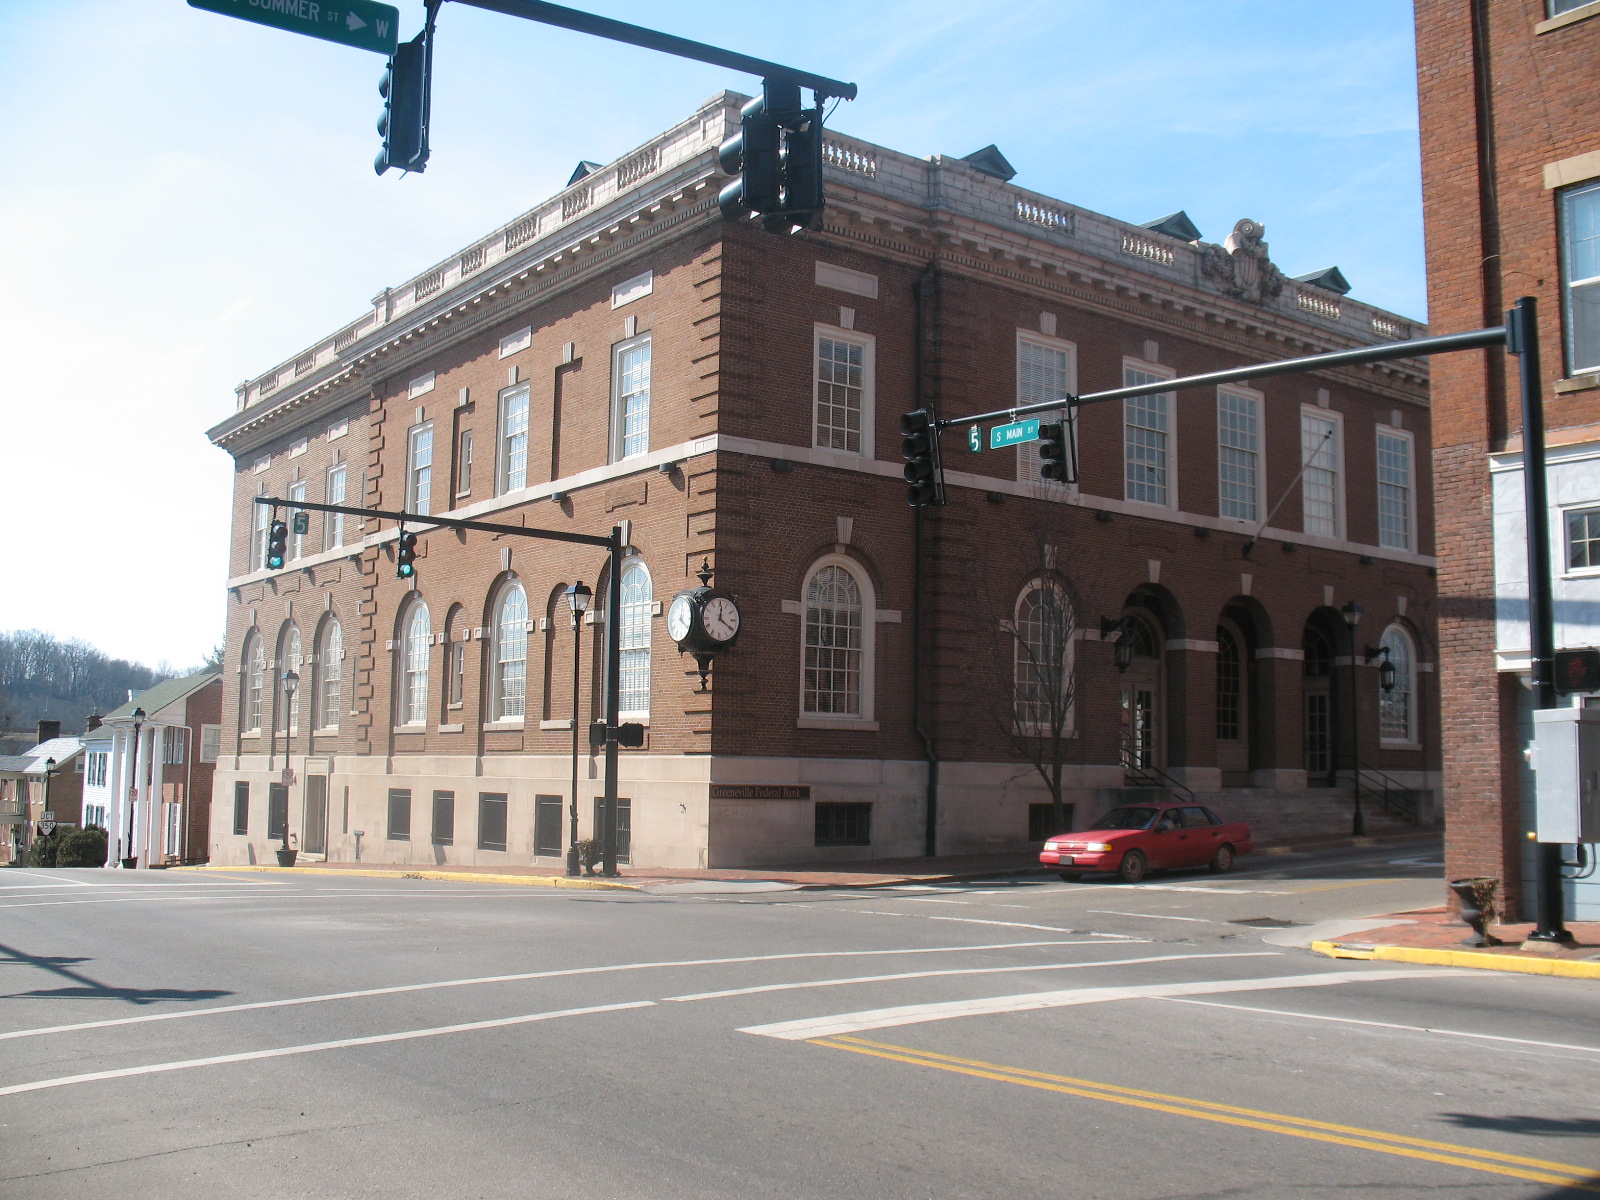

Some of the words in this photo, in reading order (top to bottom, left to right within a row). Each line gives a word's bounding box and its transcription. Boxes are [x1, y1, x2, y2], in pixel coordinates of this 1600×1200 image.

[327, 11, 339, 22] ST
[376, 18, 389, 39] W
[971, 432, 979, 452] 5
[996, 432, 1002, 442] S
[1006, 427, 1023, 440] MAIN
[1027, 426, 1034, 434] ST
[297, 516, 306, 533] 5
[712, 786, 754, 798] Greeneville
[755, 787, 781, 798] Federal
[783, 787, 801, 798] Bank
